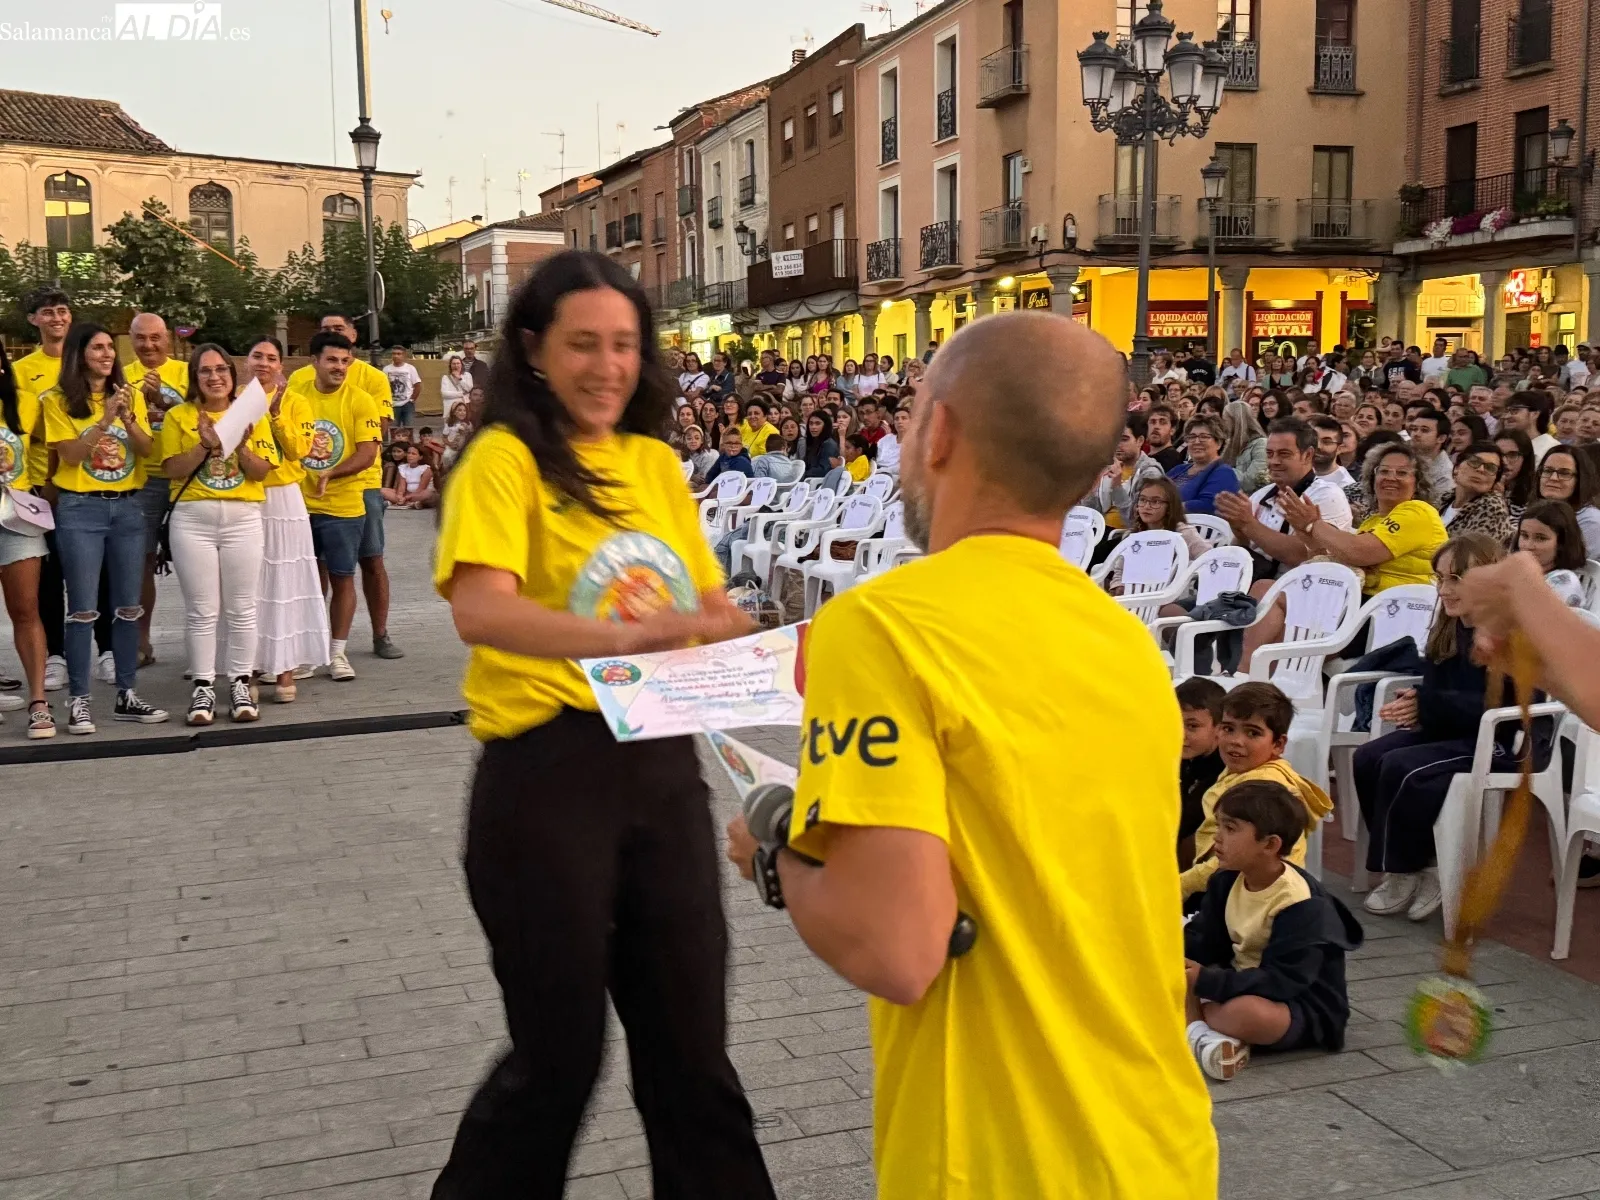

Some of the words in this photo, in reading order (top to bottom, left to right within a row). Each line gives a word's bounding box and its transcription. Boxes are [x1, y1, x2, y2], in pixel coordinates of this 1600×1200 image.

[1150, 311, 1208, 323] LIQUIDACIÓN
[1255, 311, 1311, 323] LIQUIDACIÓN
[1150, 325, 1208, 337] TOTAL
[1254, 325, 1312, 336] TOTAL
[301, 421, 315, 430] rtv
[304, 457, 330, 467] PRIX
[94, 468, 126, 480] PRIX
[801, 715, 899, 768] tve
